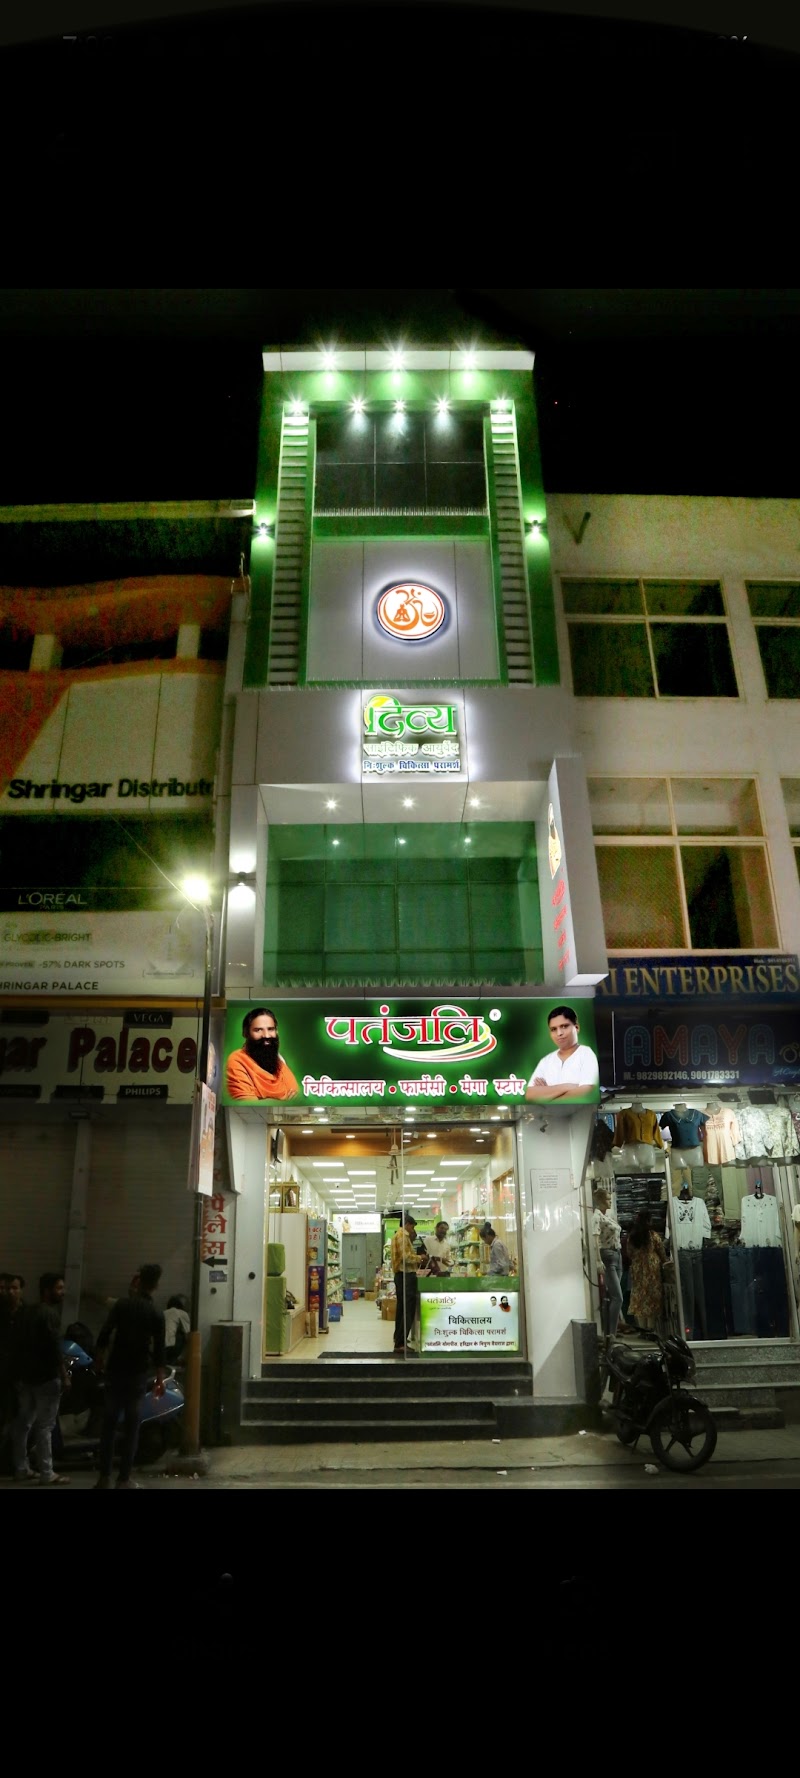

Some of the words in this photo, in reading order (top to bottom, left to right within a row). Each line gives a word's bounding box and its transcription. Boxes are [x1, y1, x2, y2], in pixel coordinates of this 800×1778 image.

[364, 694, 458, 738] दिव्य
[8, 778, 112, 802] Shringar
[64, 960, 91, 968] DARK
[93, 960, 125, 968] SPOTS
[52, 981, 99, 990] PALACE
[624, 964, 800, 996] ENTERPRISES
[133, 1013, 165, 1023] VEGA
[324, 1004, 484, 1046] पतंजलि
[67, 1027, 198, 1073] Palace
[623, 1024, 775, 1067] AMAYA
[125, 1087, 161, 1096] PHILIPS
[302, 1075, 386, 1098] चिकित्सालय
[399, 1074, 446, 1097] फार्मेसी
[493, 1074, 527, 1097] स्टोर
[448, 1315, 492, 1325] चिकित्सालय
